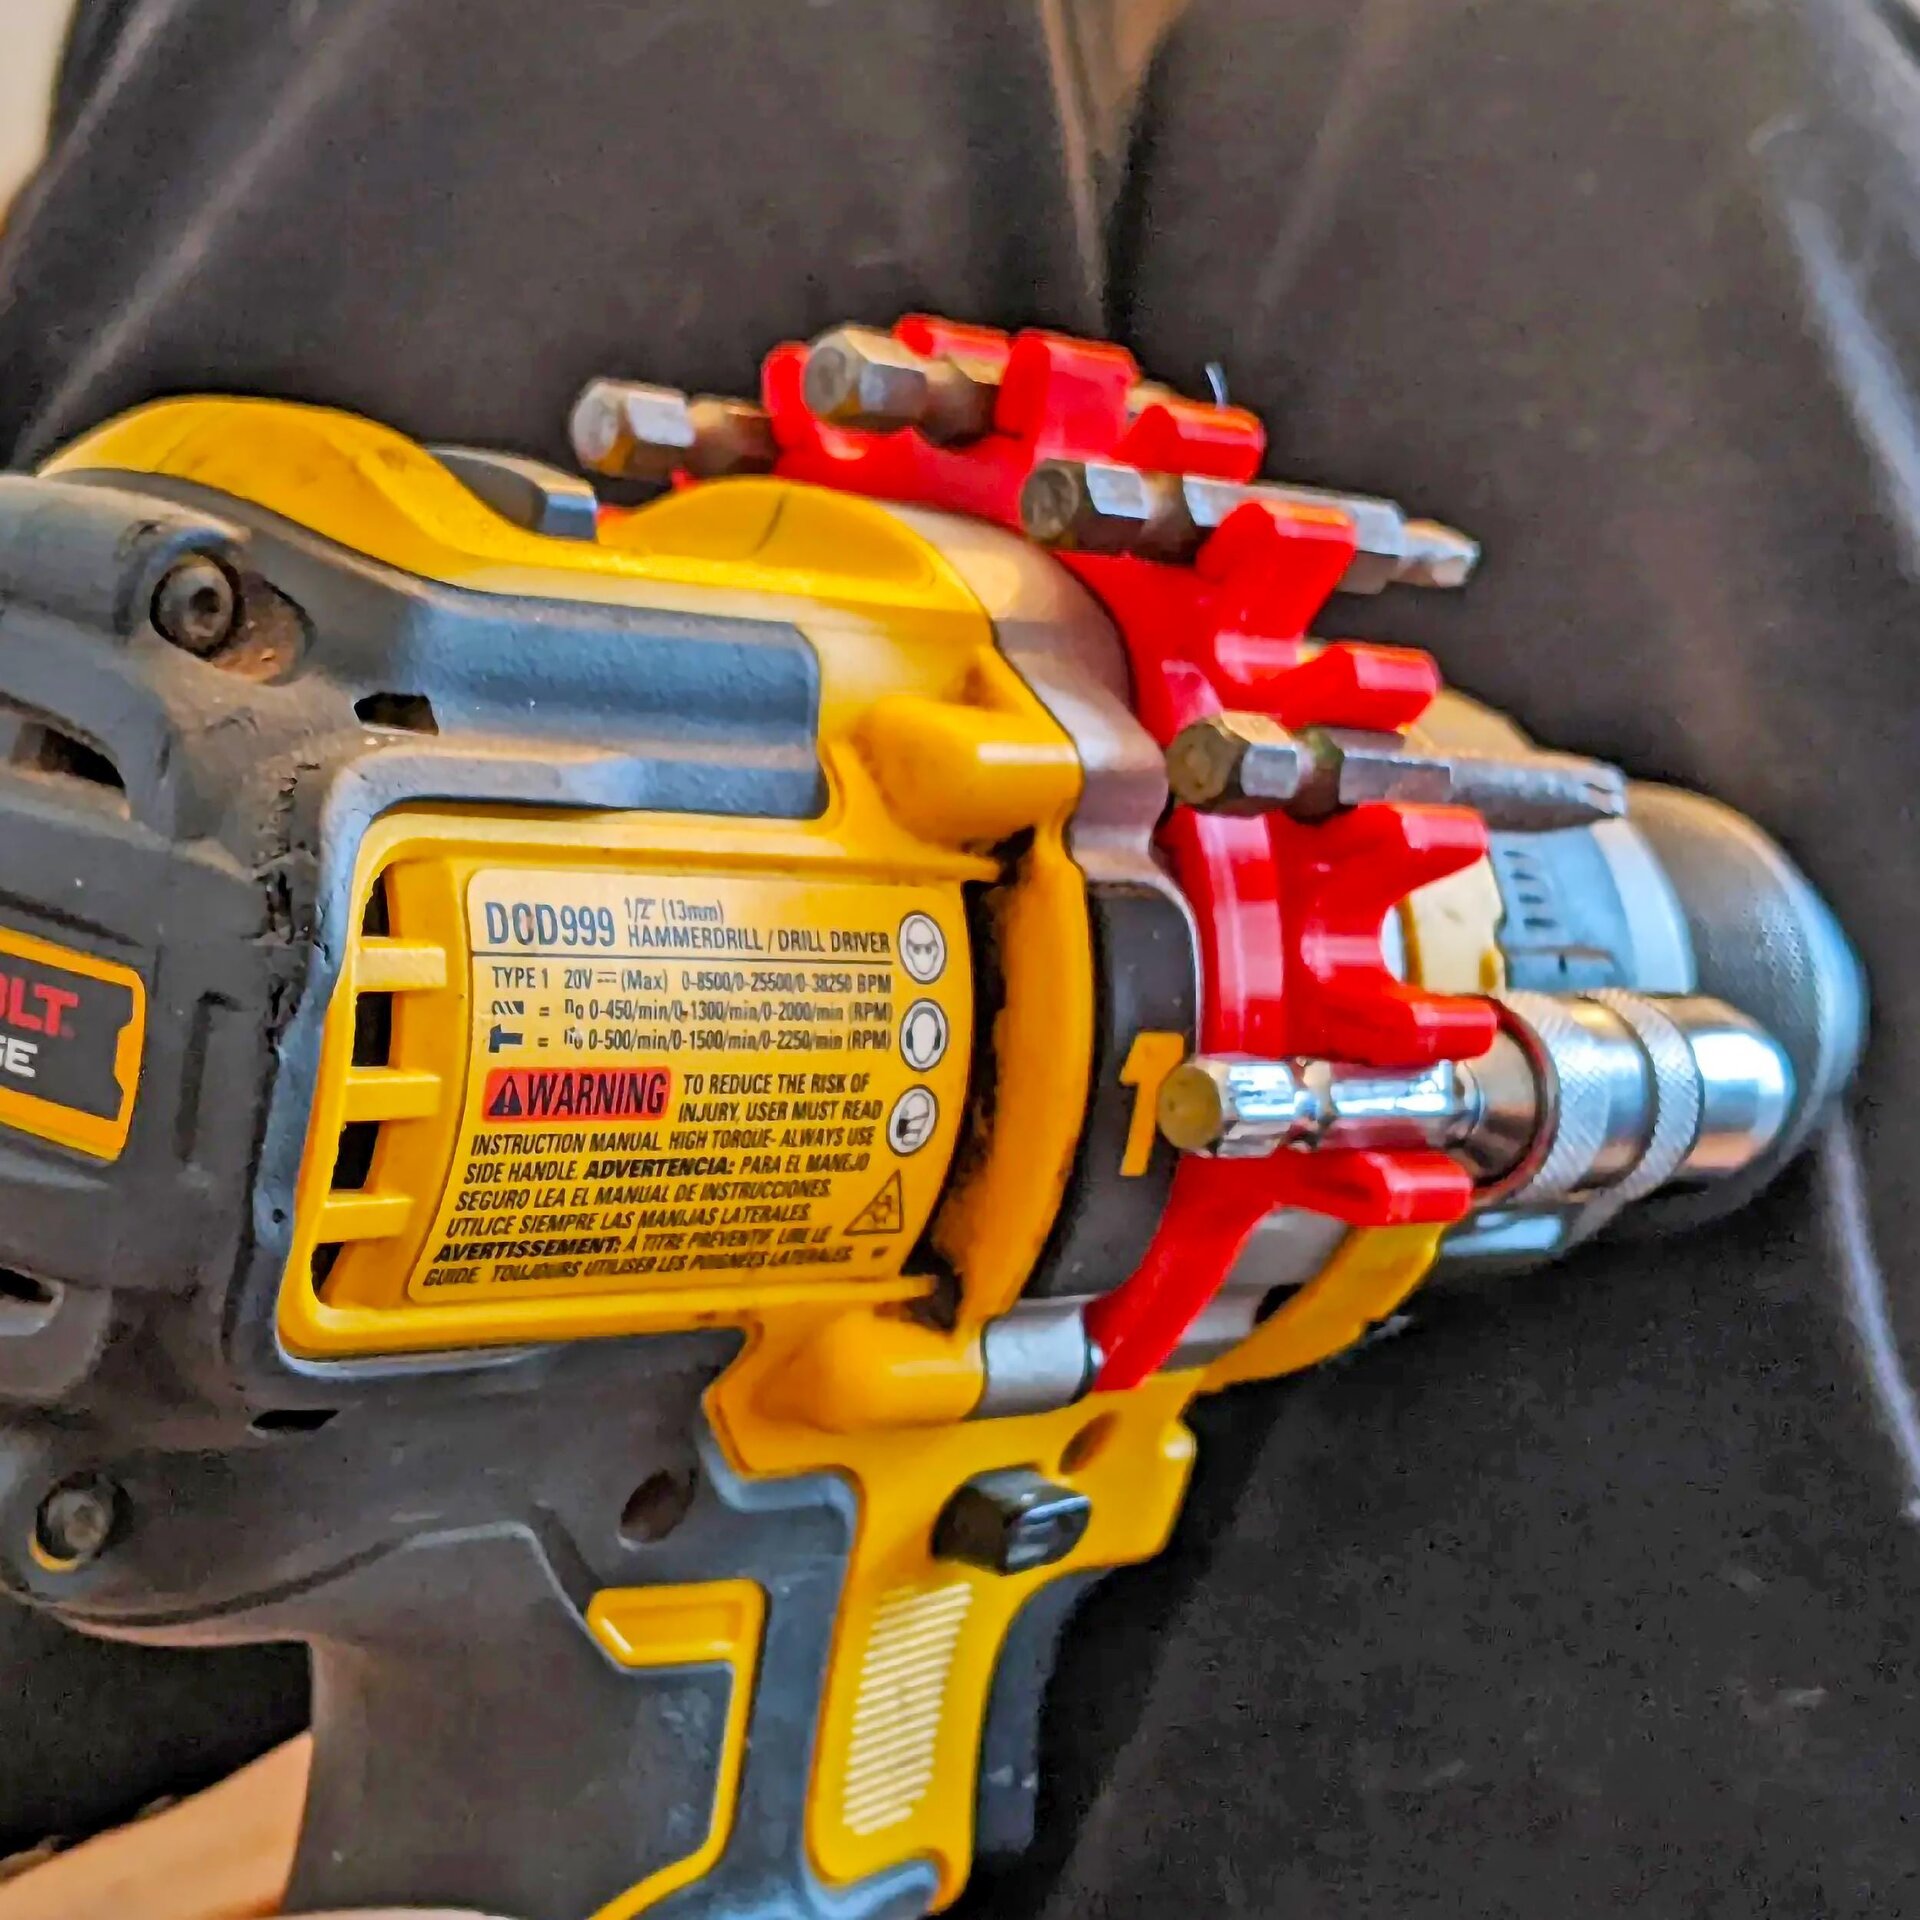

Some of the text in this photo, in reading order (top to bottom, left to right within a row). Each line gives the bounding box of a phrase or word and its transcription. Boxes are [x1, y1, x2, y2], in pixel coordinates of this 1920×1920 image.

[485, 902, 616, 947] DCD999
[662, 898, 724, 924] (13mm)
[628, 925, 763, 951] HAMMERDRILL
[777, 929, 826, 952] DRILL
[830, 930, 891, 953] DRIVER
[492, 966, 536, 989] TYPE
[541, 967, 548, 989] 1
[564, 968, 592, 990] 20V
[622, 968, 668, 993] (Max)
[857, 972, 892, 993] BPM
[846, 1029, 892, 1052] (RPM)
[0, 1033, 38, 1077] E
[527, 1074, 666, 1116] WARNING
[684, 1074, 871, 1095] TO REDUCE THE RISK OF
[745, 1103, 788, 1121] USER
[791, 1103, 840, 1121] MUST
[842, 1101, 884, 1120] READ
[1118, 1029, 1184, 1176] 1
[471, 1135, 587, 1156] INSTRUCTION
[669, 1132, 708, 1151] HIGH
[847, 1127, 876, 1147] USE
[464, 1163, 506, 1185] SIDE
[582, 1158, 736, 1180] ADVERTENCIA:
[739, 1157, 781, 1174] PARA
[785, 1155, 801, 1174] EL
[805, 1154, 871, 1173] MANEJO
[455, 1190, 531, 1212] SEGURO
[534, 1189, 566, 1208] LEA
[570, 1189, 590, 1206] EL
[594, 1186, 670, 1205] MANUAL
[674, 1185, 699, 1203] DE
[445, 1217, 517, 1239] UTILICE
[518, 1214, 599, 1234] SIEMPRE
[600, 1213, 635, 1231] LAS
[637, 1209, 719, 1229] MANIJAS
[433, 1237, 622, 1263] AVERTISSEMENT:
